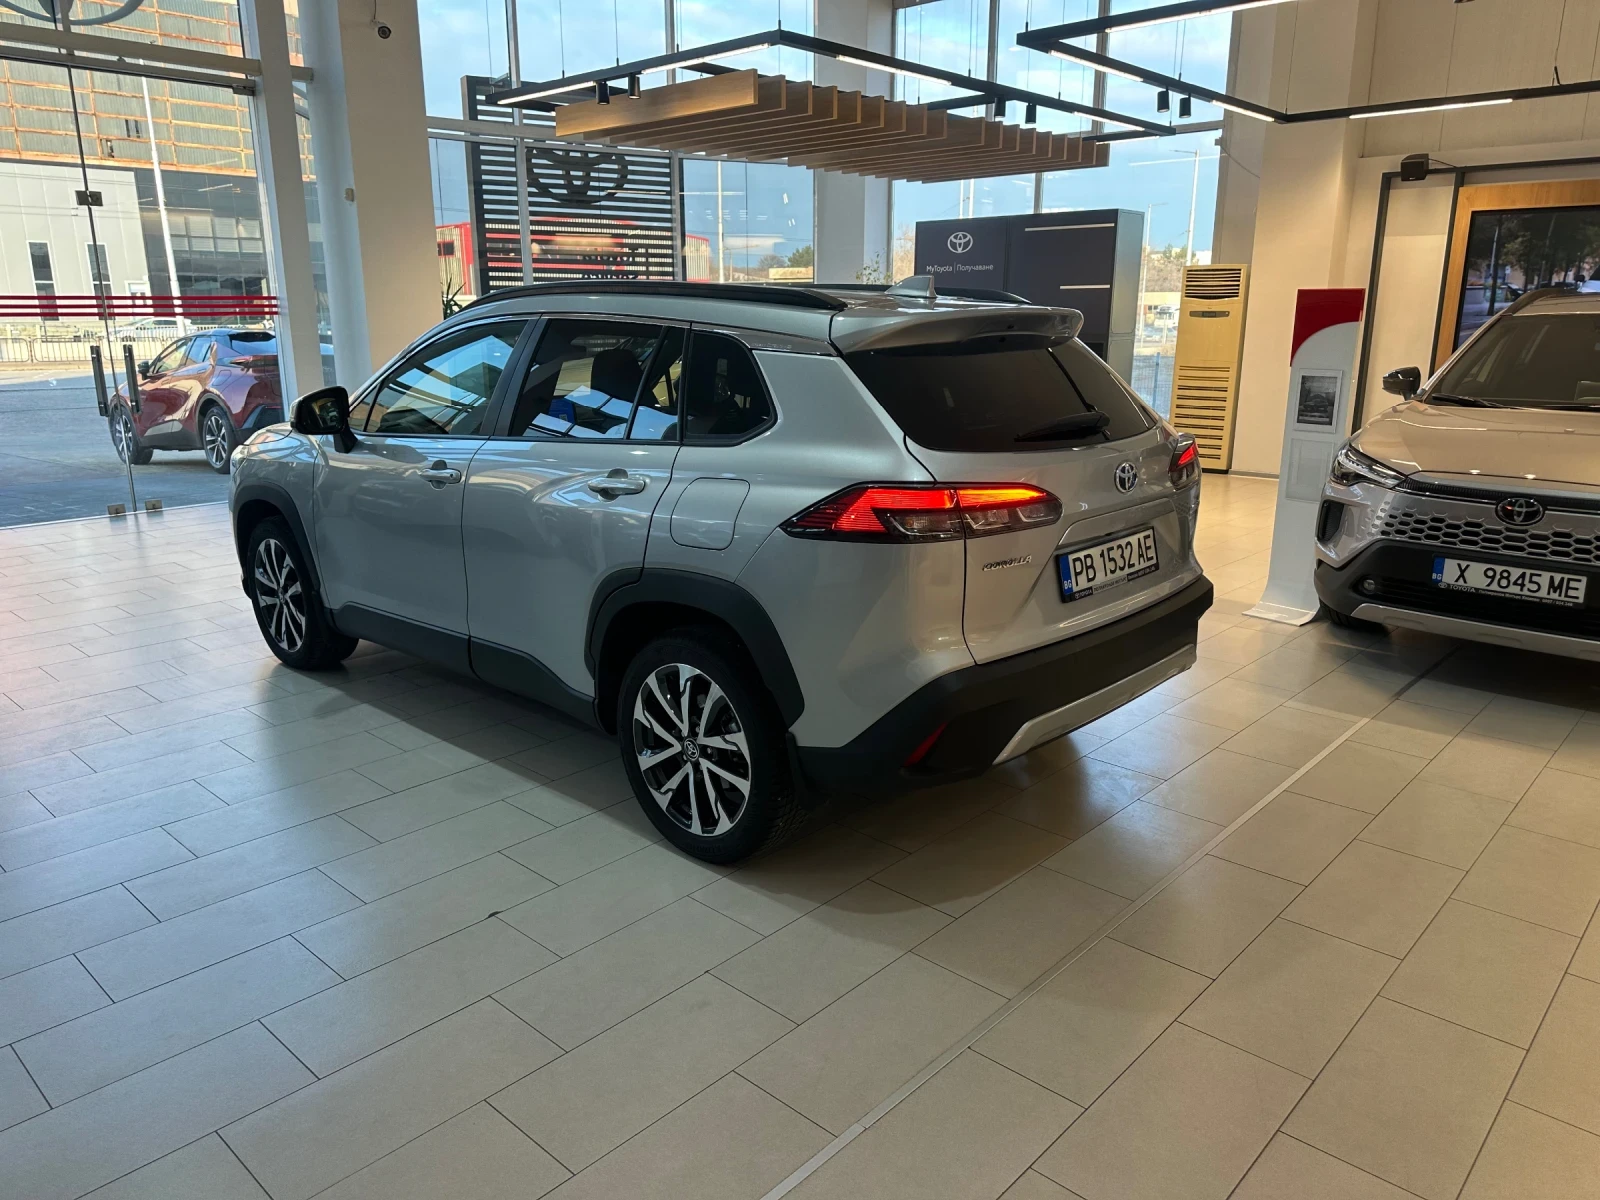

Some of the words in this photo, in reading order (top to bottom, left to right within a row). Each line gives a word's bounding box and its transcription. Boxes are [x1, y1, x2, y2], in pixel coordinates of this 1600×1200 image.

[926, 264, 953, 274] MyToyota
[956, 263, 994, 273] Получаване
[1071, 553, 1097, 587] PB
[1099, 540, 1136, 577] 1532
[1137, 533, 1155, 566] AE
[1431, 572, 1443, 580] BG
[1454, 562, 1470, 584] X
[1483, 567, 1542, 594] 9845
[1546, 574, 1582, 600] ME
[1063, 579, 1072, 590] BG
[1450, 584, 1476, 593] TOYOTA
